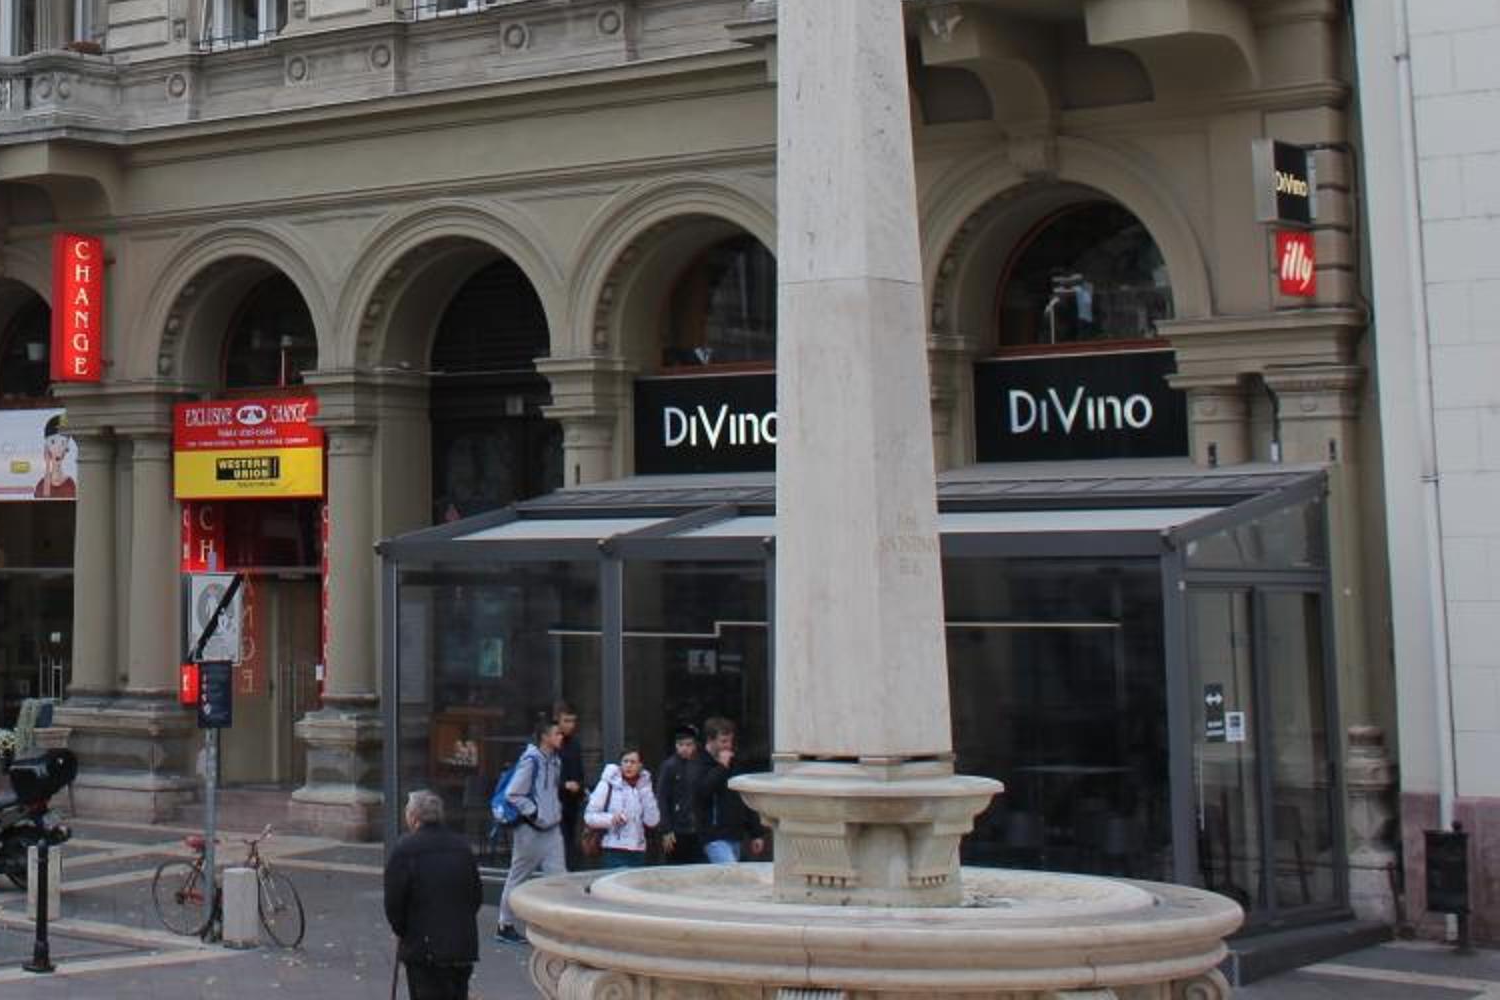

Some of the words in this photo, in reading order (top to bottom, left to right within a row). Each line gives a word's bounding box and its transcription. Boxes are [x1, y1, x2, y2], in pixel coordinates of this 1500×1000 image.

[1275, 170, 1308, 198] DiVino
[1281, 239, 1313, 292] illy
[73, 240, 91, 375] CHANGE
[1008, 386, 1154, 435] DiVino
[218, 458, 271, 469] WESTERN
[233, 469, 271, 479] UNION
